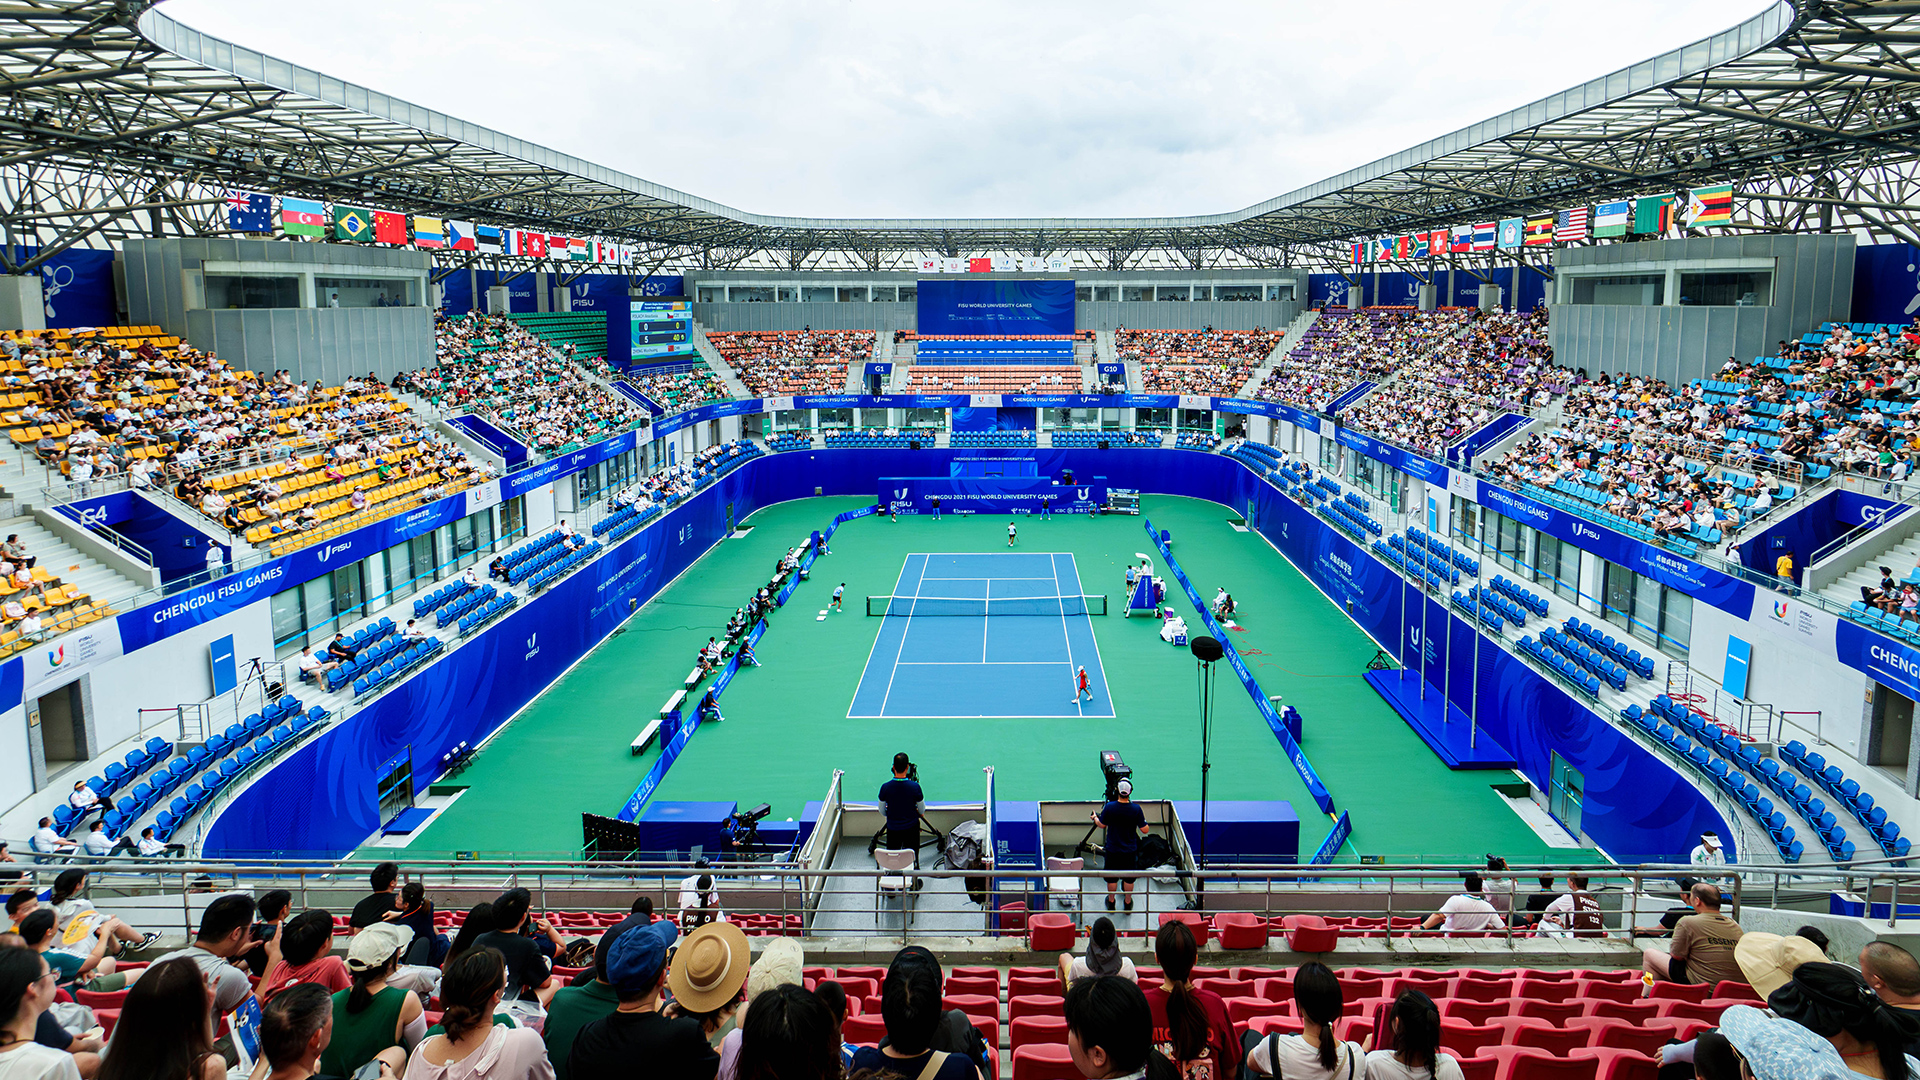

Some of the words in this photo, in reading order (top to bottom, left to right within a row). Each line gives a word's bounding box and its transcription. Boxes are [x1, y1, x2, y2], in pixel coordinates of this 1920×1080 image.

[1460, 288, 1480, 296] CHENGD
[572, 299, 594, 307] FISU
[1104, 365, 1117, 373] G10
[577, 454, 586, 462] FISU
[511, 472, 534, 488] CHENGDU
[533, 468, 544, 480] FISU
[544, 463, 559, 476] GAMES
[1487, 489, 1514, 506] CHENGDU
[1513, 500, 1527, 512] FISU
[1527, 506, 1549, 521] GAMES
[80, 504, 107, 525] G4
[1860, 504, 1888, 525] G7
[1582, 527, 1600, 541] FISU
[185, 538, 191, 546] E
[331, 541, 352, 555] FISU
[1776, 539, 1784, 547] N
[597, 584, 605, 594] FISU
[605, 573, 618, 588] WORLD
[618, 561, 636, 580] UNIVERSITY
[635, 552, 648, 566] GAMES
[153, 591, 215, 624] CHENGDU
[217, 581, 243, 601] FISU
[246, 566, 283, 588] GAMES
[525, 646, 540, 661] FISU
[1870, 645, 1920, 680] CHENG
[1579, 896, 1599, 909] PHOTO
[685, 914, 711, 923] PHO
[1589, 915, 1600, 925] 132
[1707, 937, 1739, 946] ESSENT
